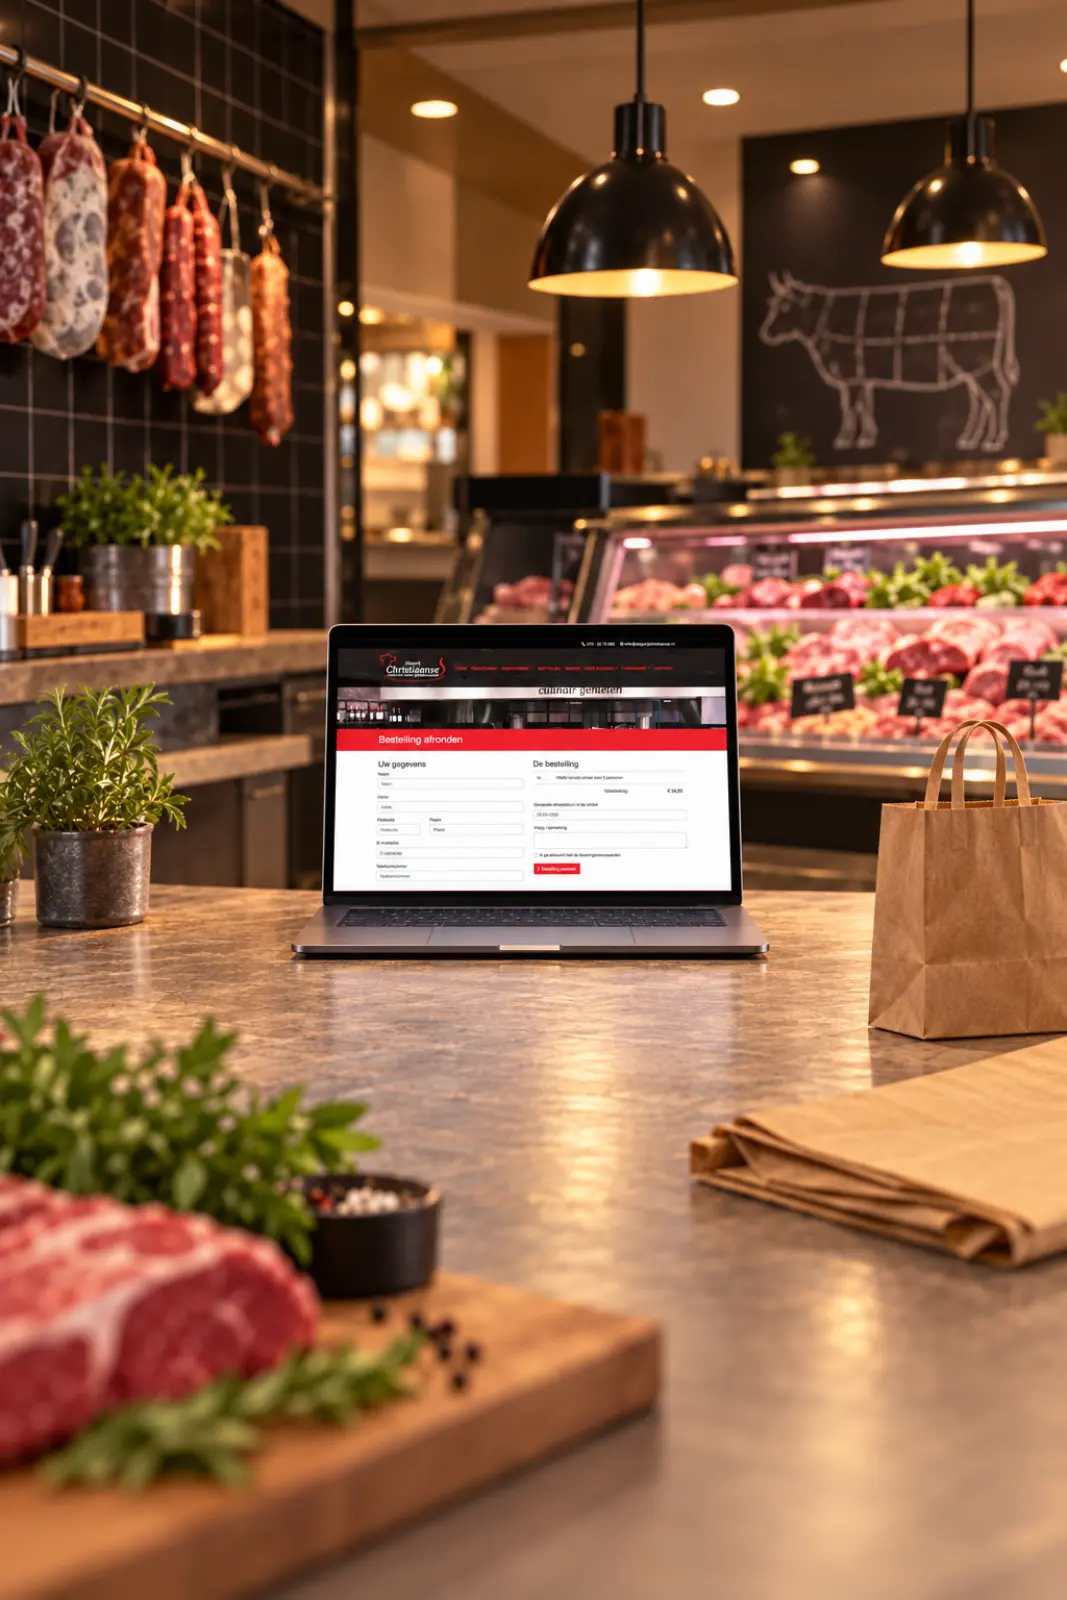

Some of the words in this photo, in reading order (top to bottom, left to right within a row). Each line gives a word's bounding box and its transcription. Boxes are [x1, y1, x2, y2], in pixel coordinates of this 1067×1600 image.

[378, 734, 421, 746] Bestelling
[423, 734, 464, 745] afronden
[378, 760, 391, 769] Uw
[392, 760, 427, 771] gegevens
[532, 759, 543, 768] De
[545, 759, 580, 770] bestelling
